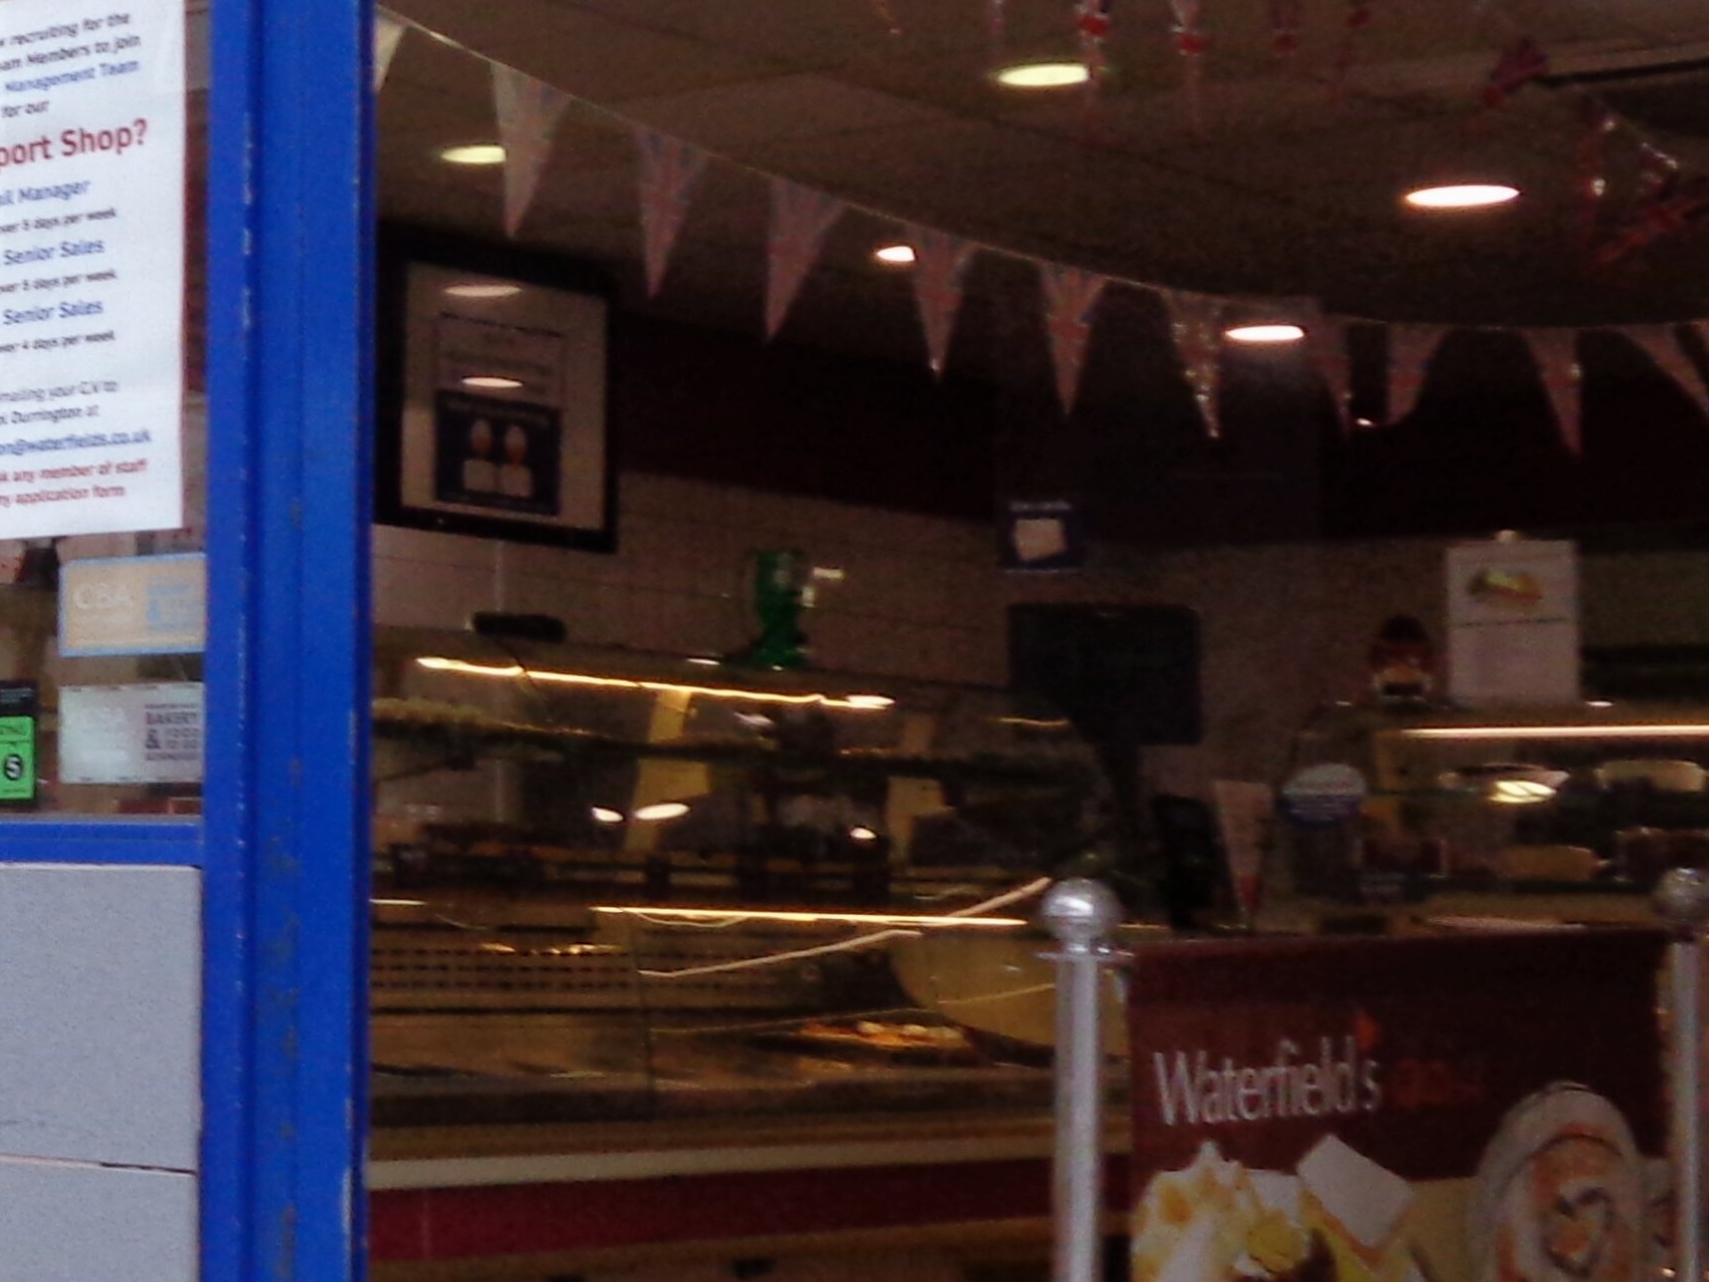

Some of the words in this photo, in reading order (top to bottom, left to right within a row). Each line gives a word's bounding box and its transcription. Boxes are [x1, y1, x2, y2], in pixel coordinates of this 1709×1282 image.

[59, 117, 149, 157] Shop?
[17, 179, 92, 204] Manager
[3, 246, 57, 267] Senior
[59, 239, 106, 259] Sales
[2, 307, 56, 326] Senior
[58, 299, 104, 320] Sales
[5, 754, 23, 780] 5
